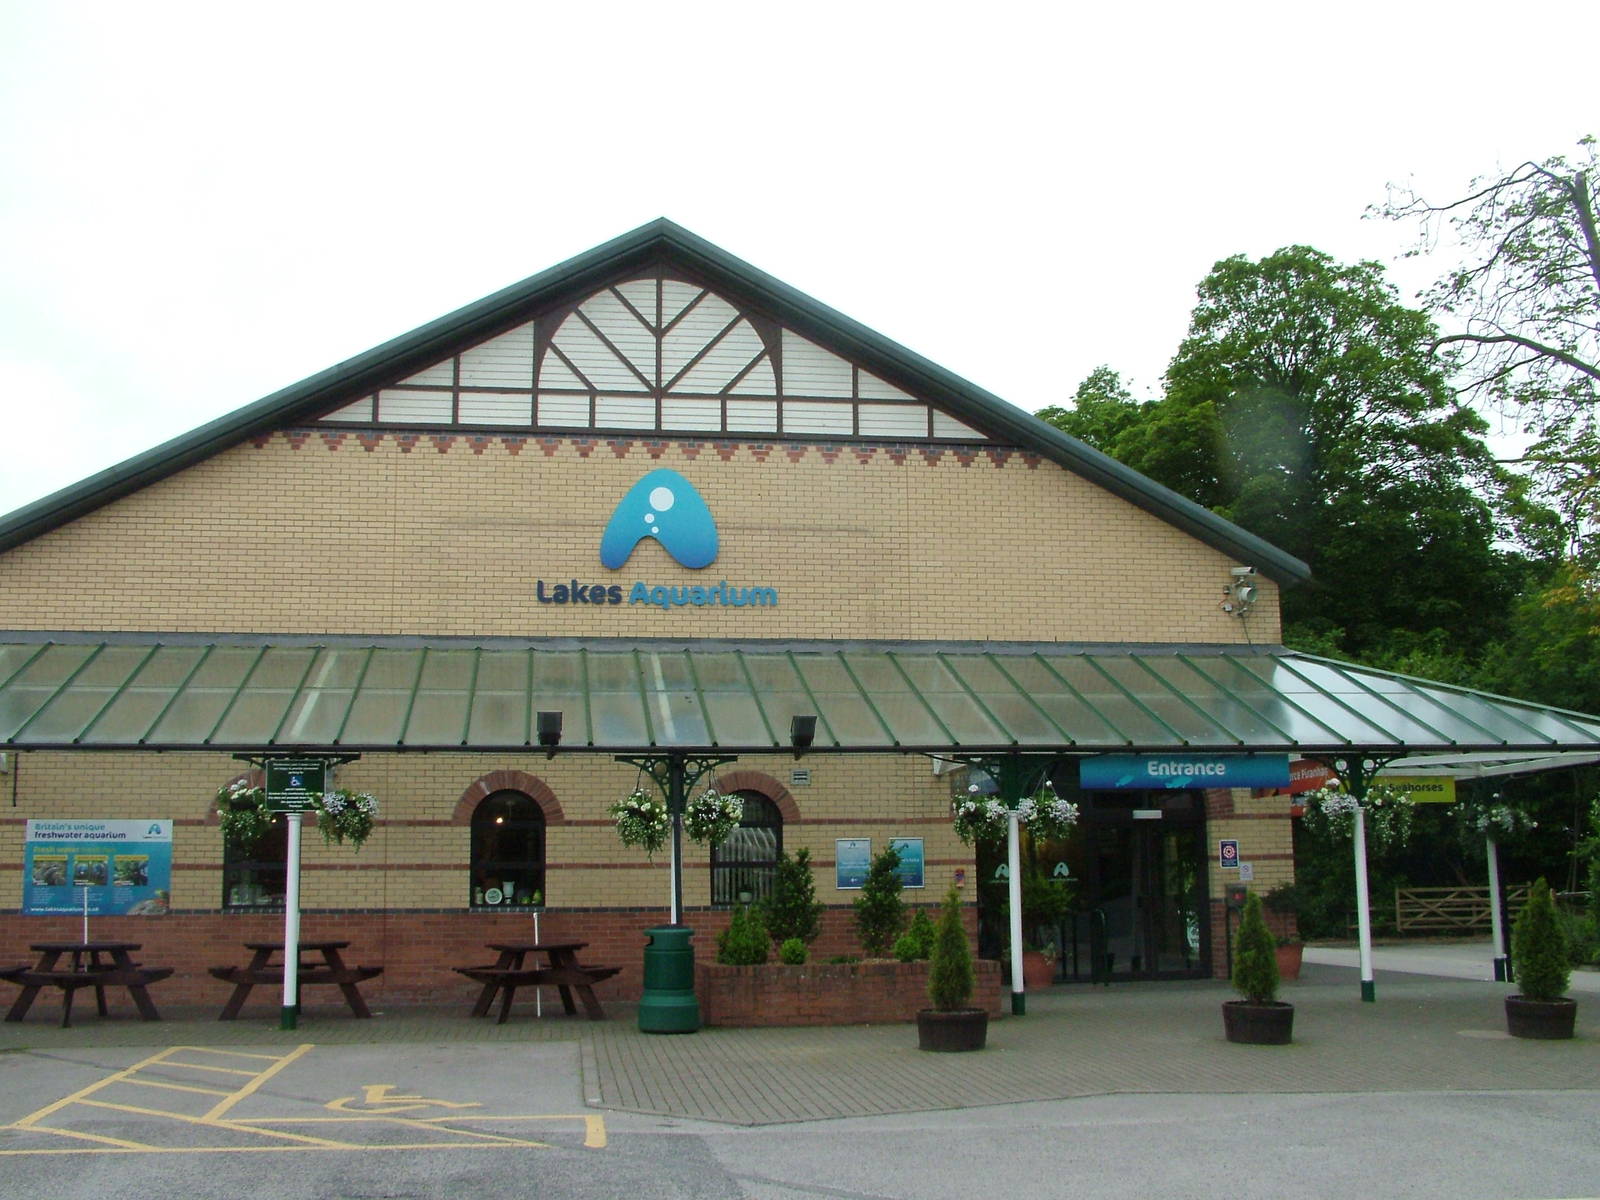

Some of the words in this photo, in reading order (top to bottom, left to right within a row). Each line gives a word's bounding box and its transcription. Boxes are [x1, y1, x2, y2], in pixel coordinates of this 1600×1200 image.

[537, 579, 622, 604] Lakes
[628, 580, 778, 610] Aquarium
[1147, 761, 1226, 775] Entrance
[34, 823, 72, 831] Britain's
[73, 824, 106, 832] unique
[34, 831, 82, 839] freshwater
[84, 831, 127, 840] aquarium
